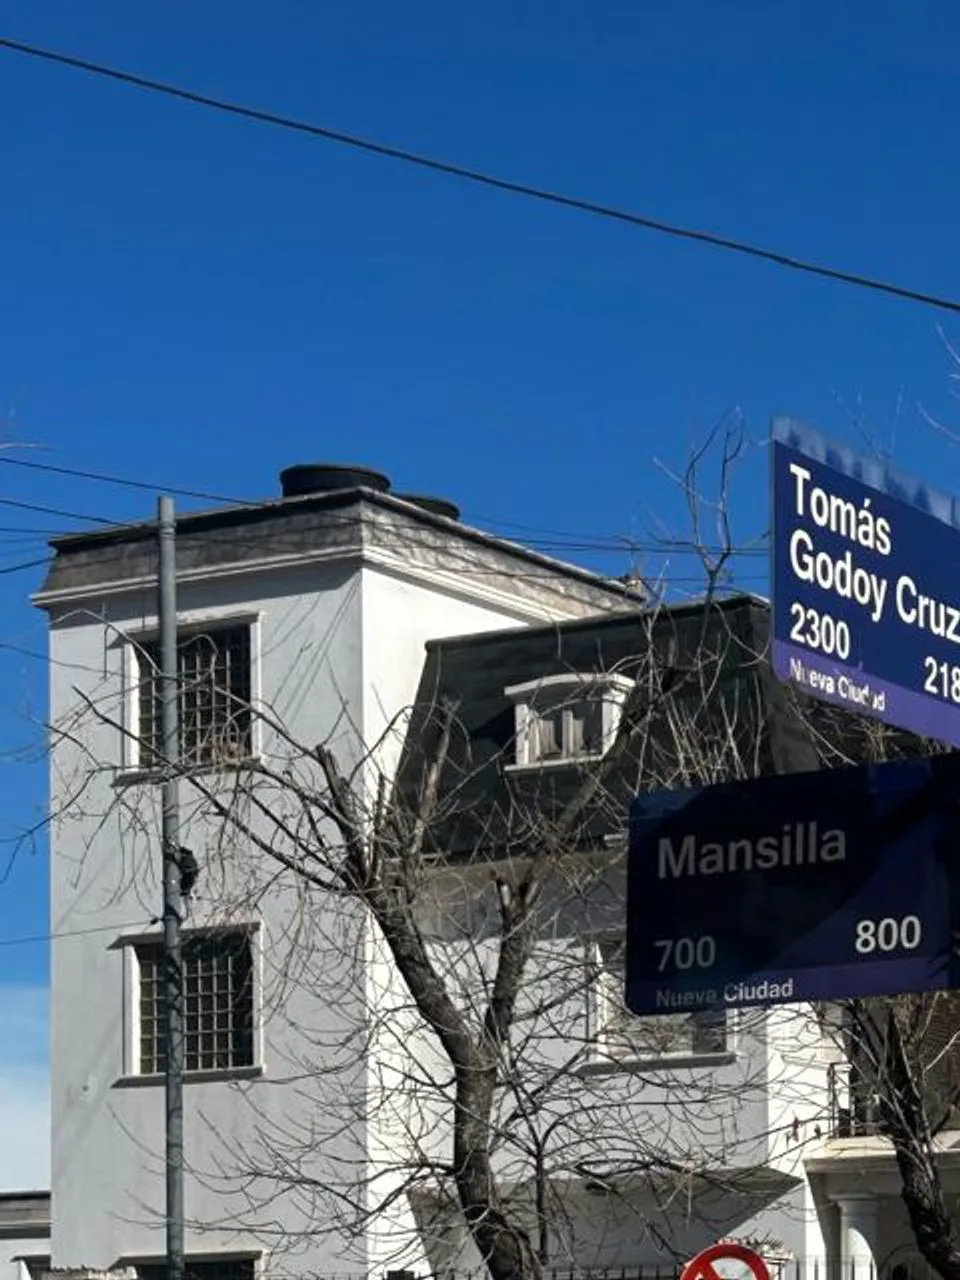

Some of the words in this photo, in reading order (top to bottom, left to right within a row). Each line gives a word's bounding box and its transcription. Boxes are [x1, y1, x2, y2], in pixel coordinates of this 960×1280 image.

[790, 463, 891, 556] Tomás
[790, 529, 888, 622] Godoy
[789, 603, 850, 660] 2300
[657, 821, 846, 879] Mansilla
[653, 935, 716, 973] 700
[855, 914, 921, 954] 800
[655, 988, 717, 1008] Nueva
[723, 977, 794, 1002] Ciudad
